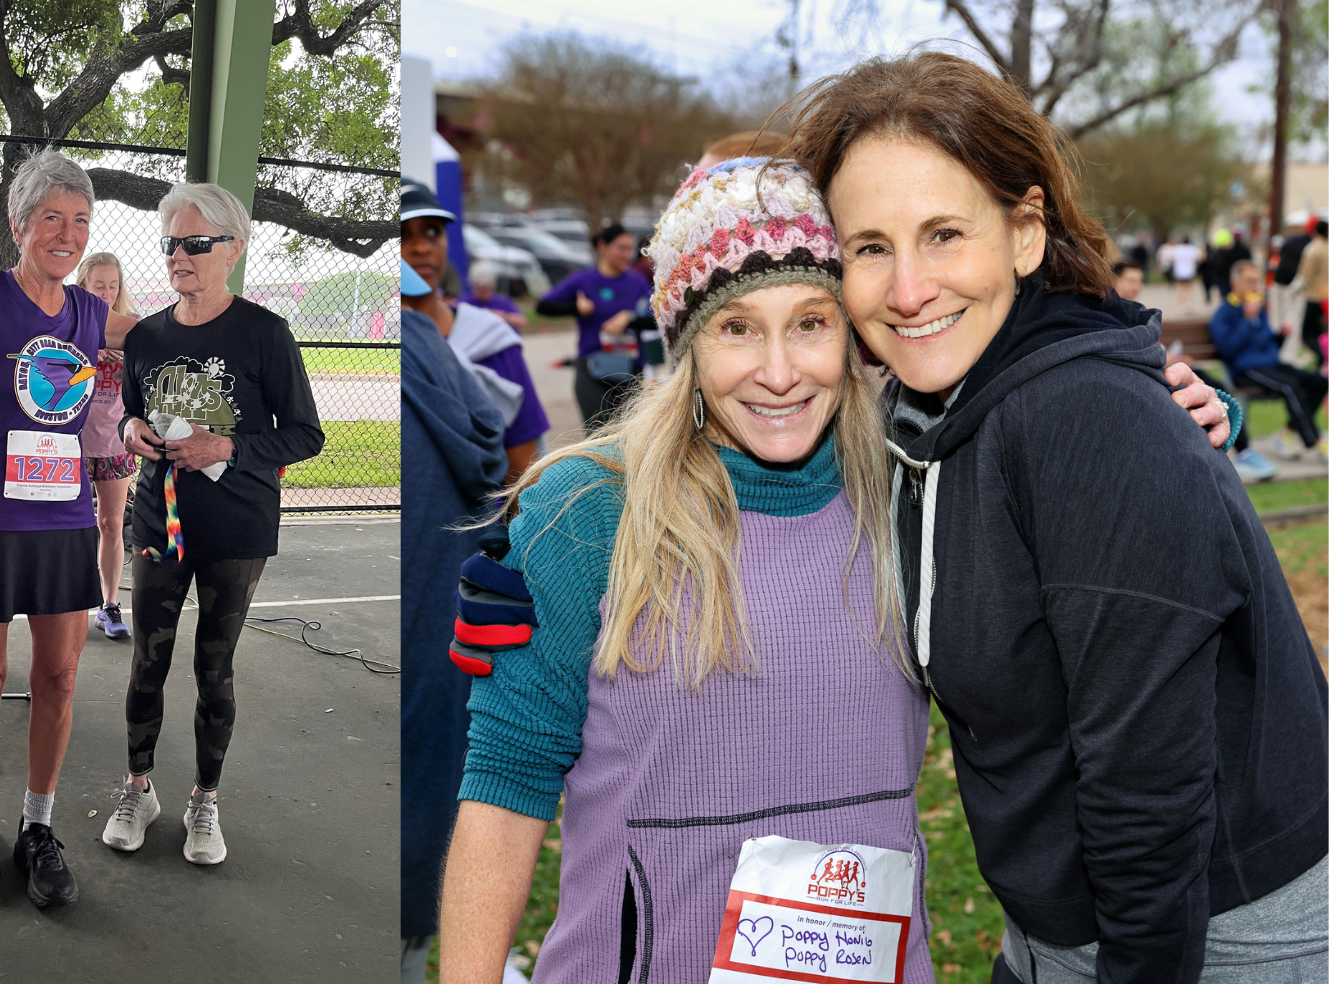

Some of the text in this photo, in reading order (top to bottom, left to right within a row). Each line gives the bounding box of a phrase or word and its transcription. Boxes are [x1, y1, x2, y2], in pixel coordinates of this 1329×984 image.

[34, 393, 89, 421] HOUSTON TEXAS
[15, 456, 74, 482] 1272
[808, 884, 865, 903] POPPY'S
[806, 917, 826, 926] honor
[832, 921, 858, 931] memory
[781, 925, 829, 951] Poppy
[785, 947, 827, 973] Poppy
